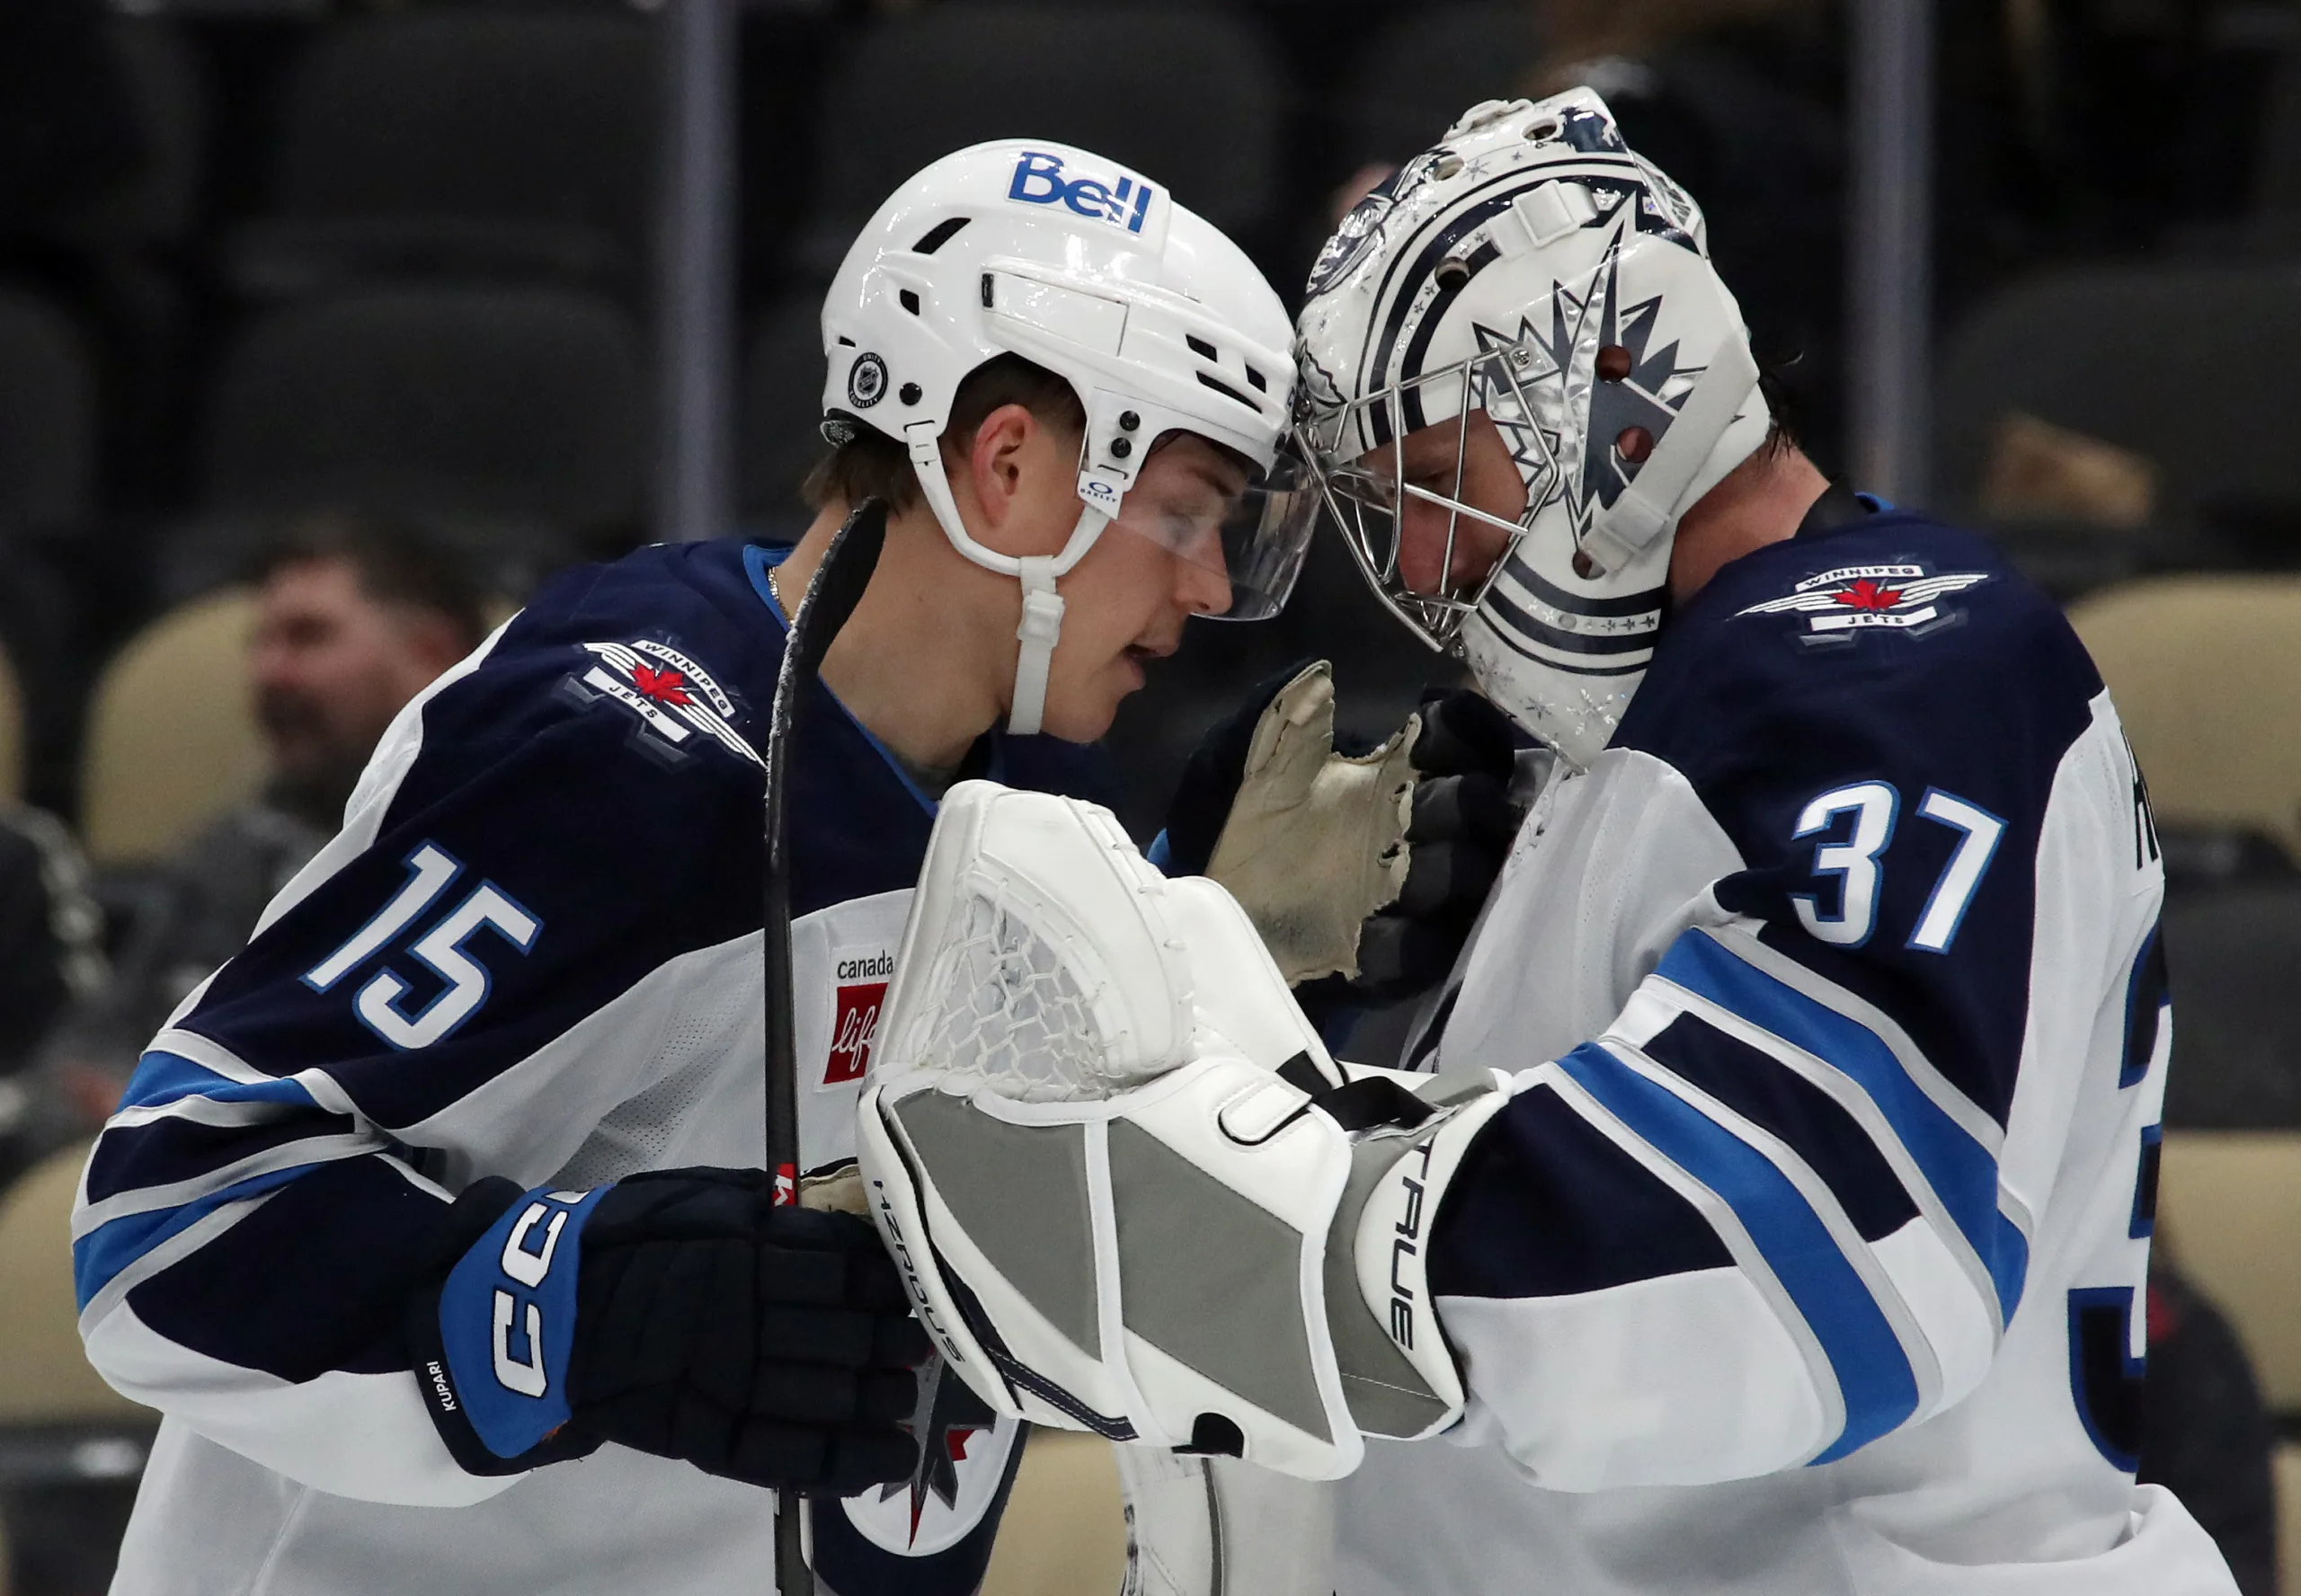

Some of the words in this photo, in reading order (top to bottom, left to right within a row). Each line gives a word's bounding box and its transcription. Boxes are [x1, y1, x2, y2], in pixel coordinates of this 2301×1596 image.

[1008, 151, 1152, 233] Bell
[1080, 488, 1116, 502] OAKLEY
[1805, 567, 1915, 586] WINNIPEG
[1848, 616, 1905, 625] JETS
[609, 685, 659, 719] JETS
[644, 643, 728, 711] WINNIPEG
[1787, 780, 2010, 955] 37
[298, 838, 545, 1051] 15
[838, 949, 893, 980] canada
[1391, 1140, 1434, 1351] TRUE
[426, 1361, 457, 1412] KUPARI
